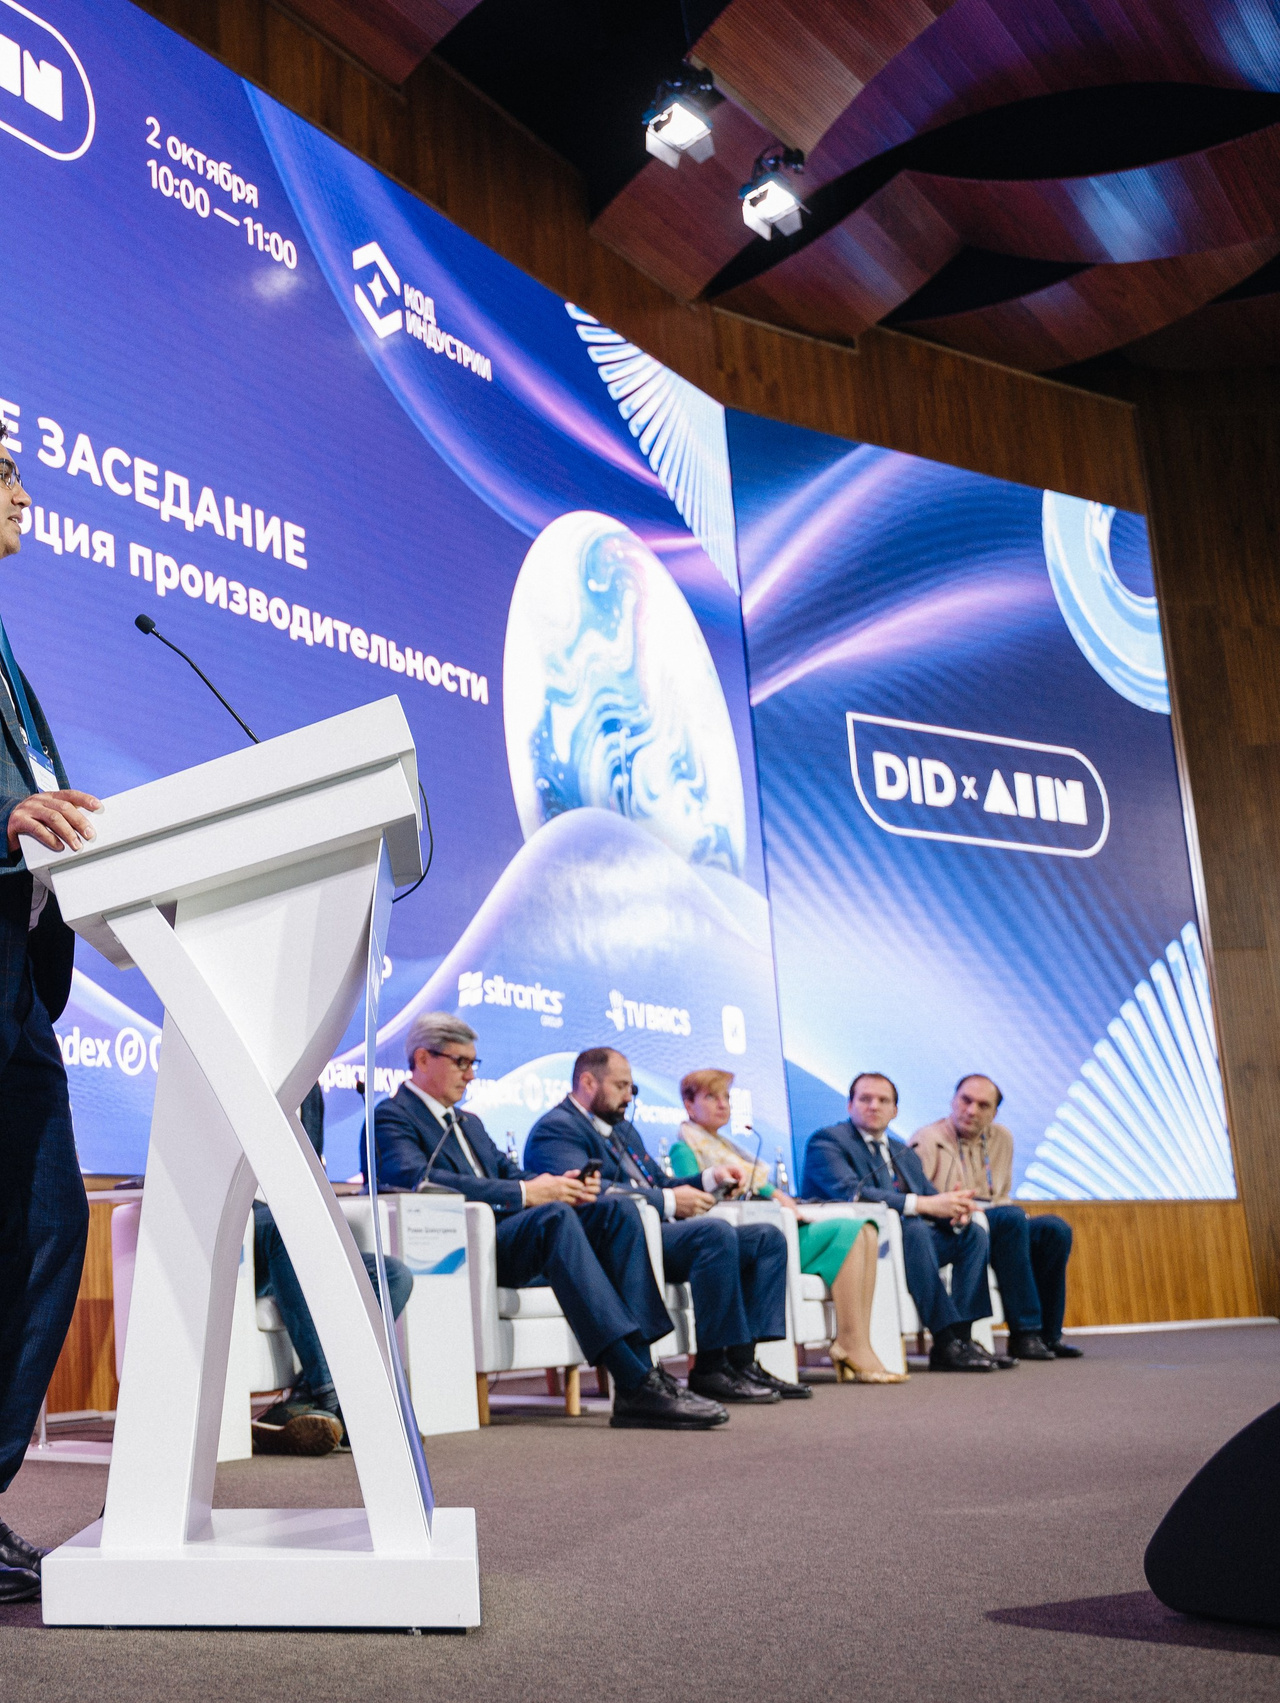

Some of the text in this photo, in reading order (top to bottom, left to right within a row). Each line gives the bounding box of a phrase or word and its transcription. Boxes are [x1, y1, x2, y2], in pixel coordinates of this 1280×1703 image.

[145, 116, 259, 208] 2 октября
[146, 159, 210, 218] 10:00
[243, 216, 298, 270] 11:00
[403, 283, 437, 326] КОД
[405, 309, 492, 382] ИНДУСТРИИ
[37, 416, 308, 570] ЗАСЕДАНИЕ
[129, 542, 489, 705] производительности
[872, 750, 957, 808] DID
[483, 975, 563, 1015] sitronics
